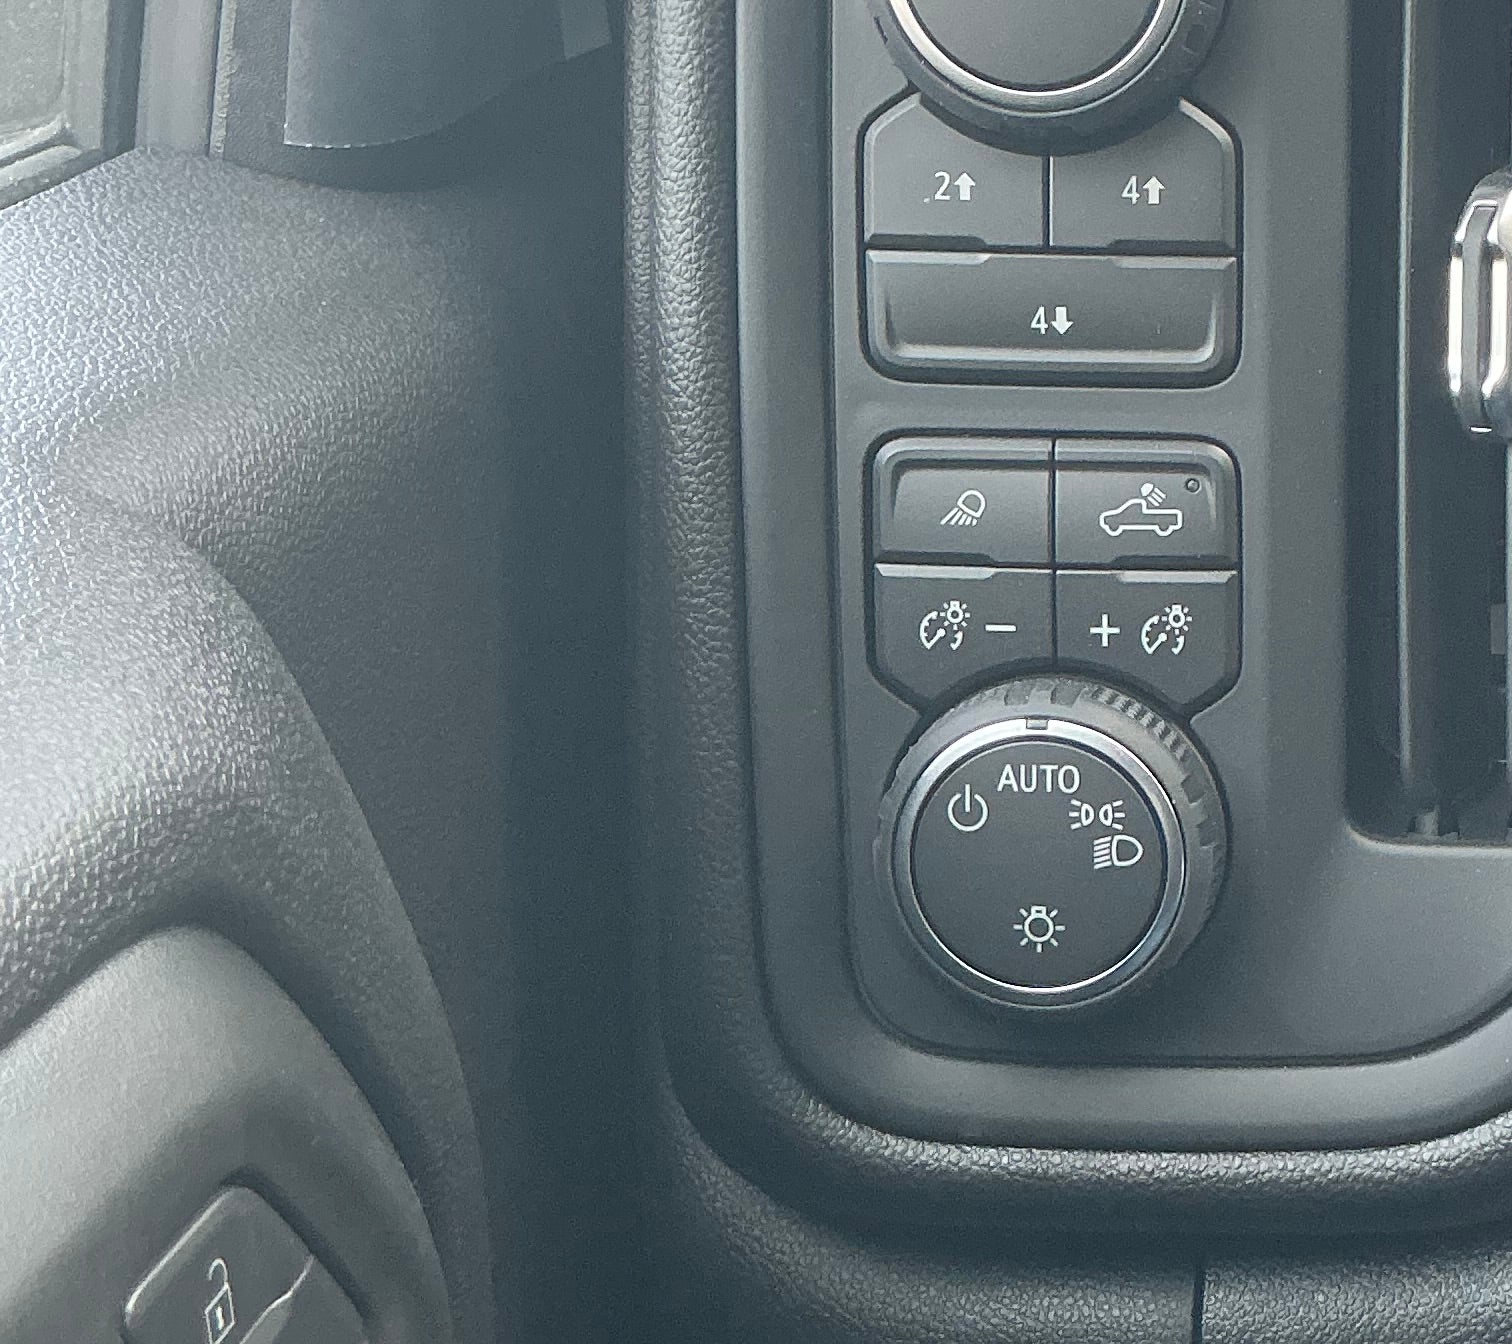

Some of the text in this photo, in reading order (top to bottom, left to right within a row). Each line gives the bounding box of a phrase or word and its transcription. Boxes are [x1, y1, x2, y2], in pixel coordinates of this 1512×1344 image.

[933, 171, 951, 201] 2
[1121, 175, 1141, 205] 4
[1030, 305, 1049, 335] 4
[997, 763, 1081, 794] AUTO
